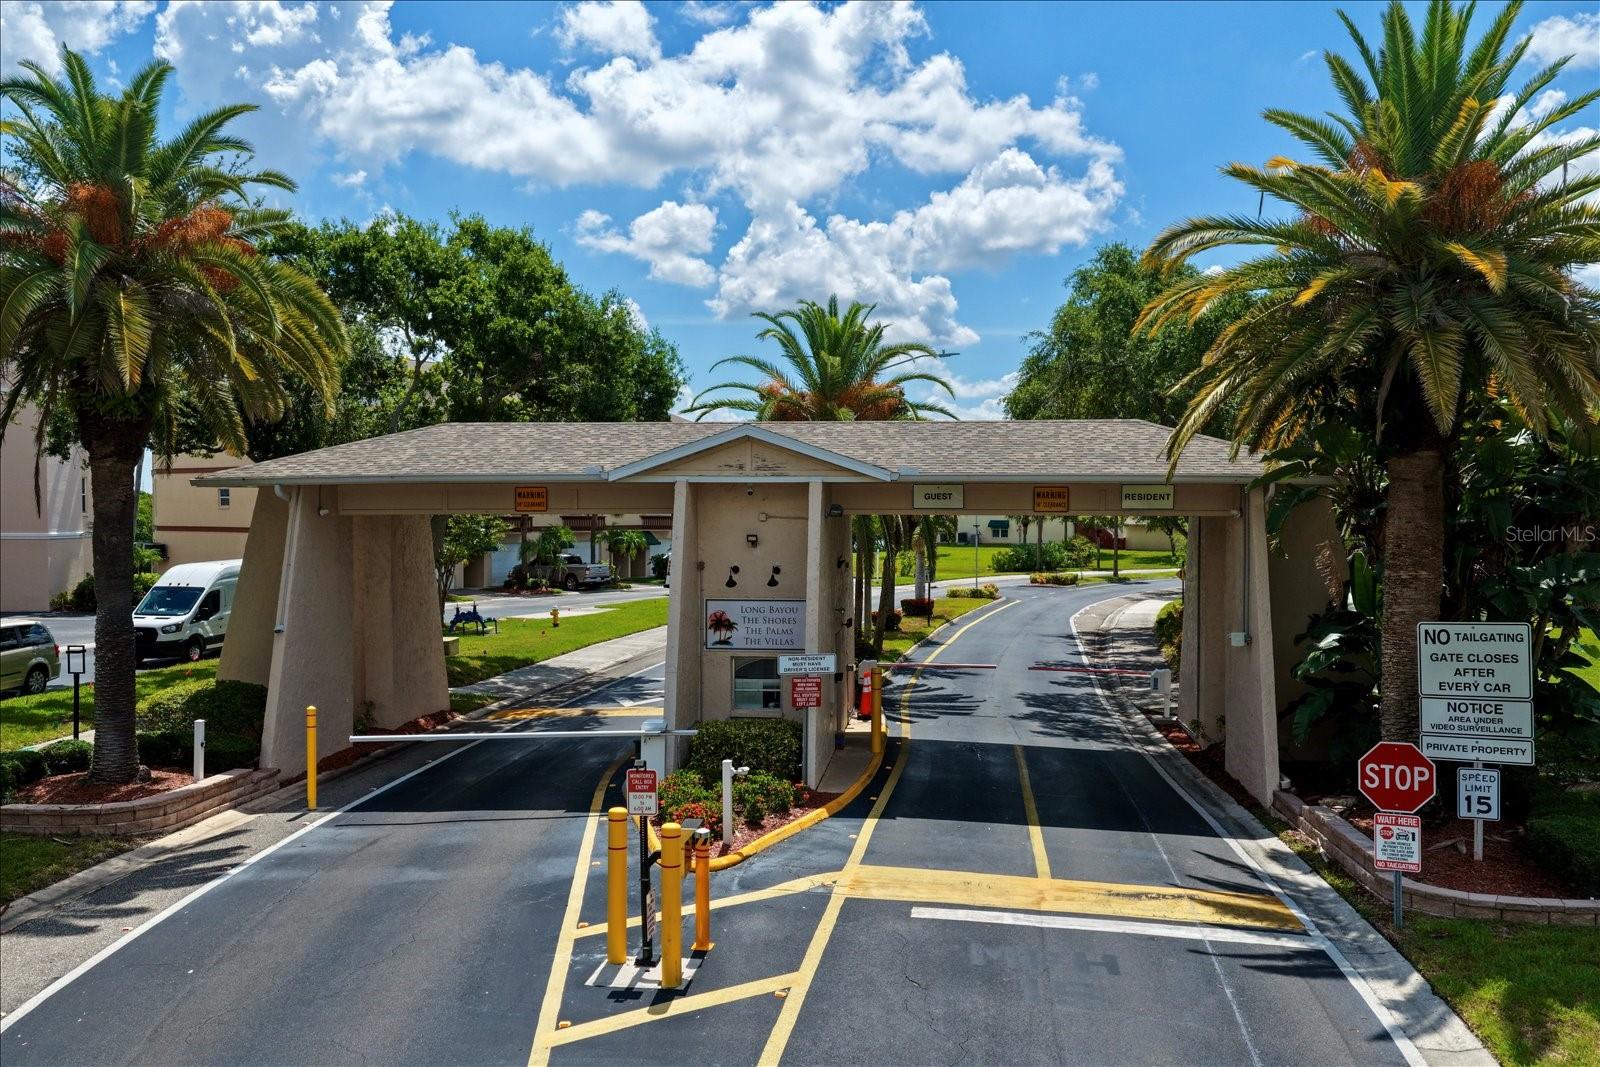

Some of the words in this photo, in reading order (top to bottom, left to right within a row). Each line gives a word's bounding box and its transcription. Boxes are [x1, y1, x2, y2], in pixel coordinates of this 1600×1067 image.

[741, 606, 766, 614] LONG
[1424, 629, 1450, 645] NO
[1454, 633, 1524, 642] TAILGATING
[1430, 653, 1464, 662] GATE
[1467, 654, 1519, 663] CLOSES
[1454, 668, 1495, 678] AFTER
[1439, 682, 1480, 691] EVERY
[1484, 683, 1511, 692] CAR
[1447, 702, 1504, 715] NOTICE
[1458, 724, 1522, 734] SURVEILLANCE
[1426, 743, 1468, 752] PRIVATE
[1471, 746, 1526, 756] PROPERTY
[1364, 763, 1430, 791] STOP
[1462, 773, 1496, 783] SPEED
[1465, 784, 1492, 793] LIMIT
[1465, 795, 1492, 814] 15
[1377, 816, 1396, 824] WAIT
[1398, 817, 1418, 826] HERE
[1387, 862, 1418, 870] TAILGATING
